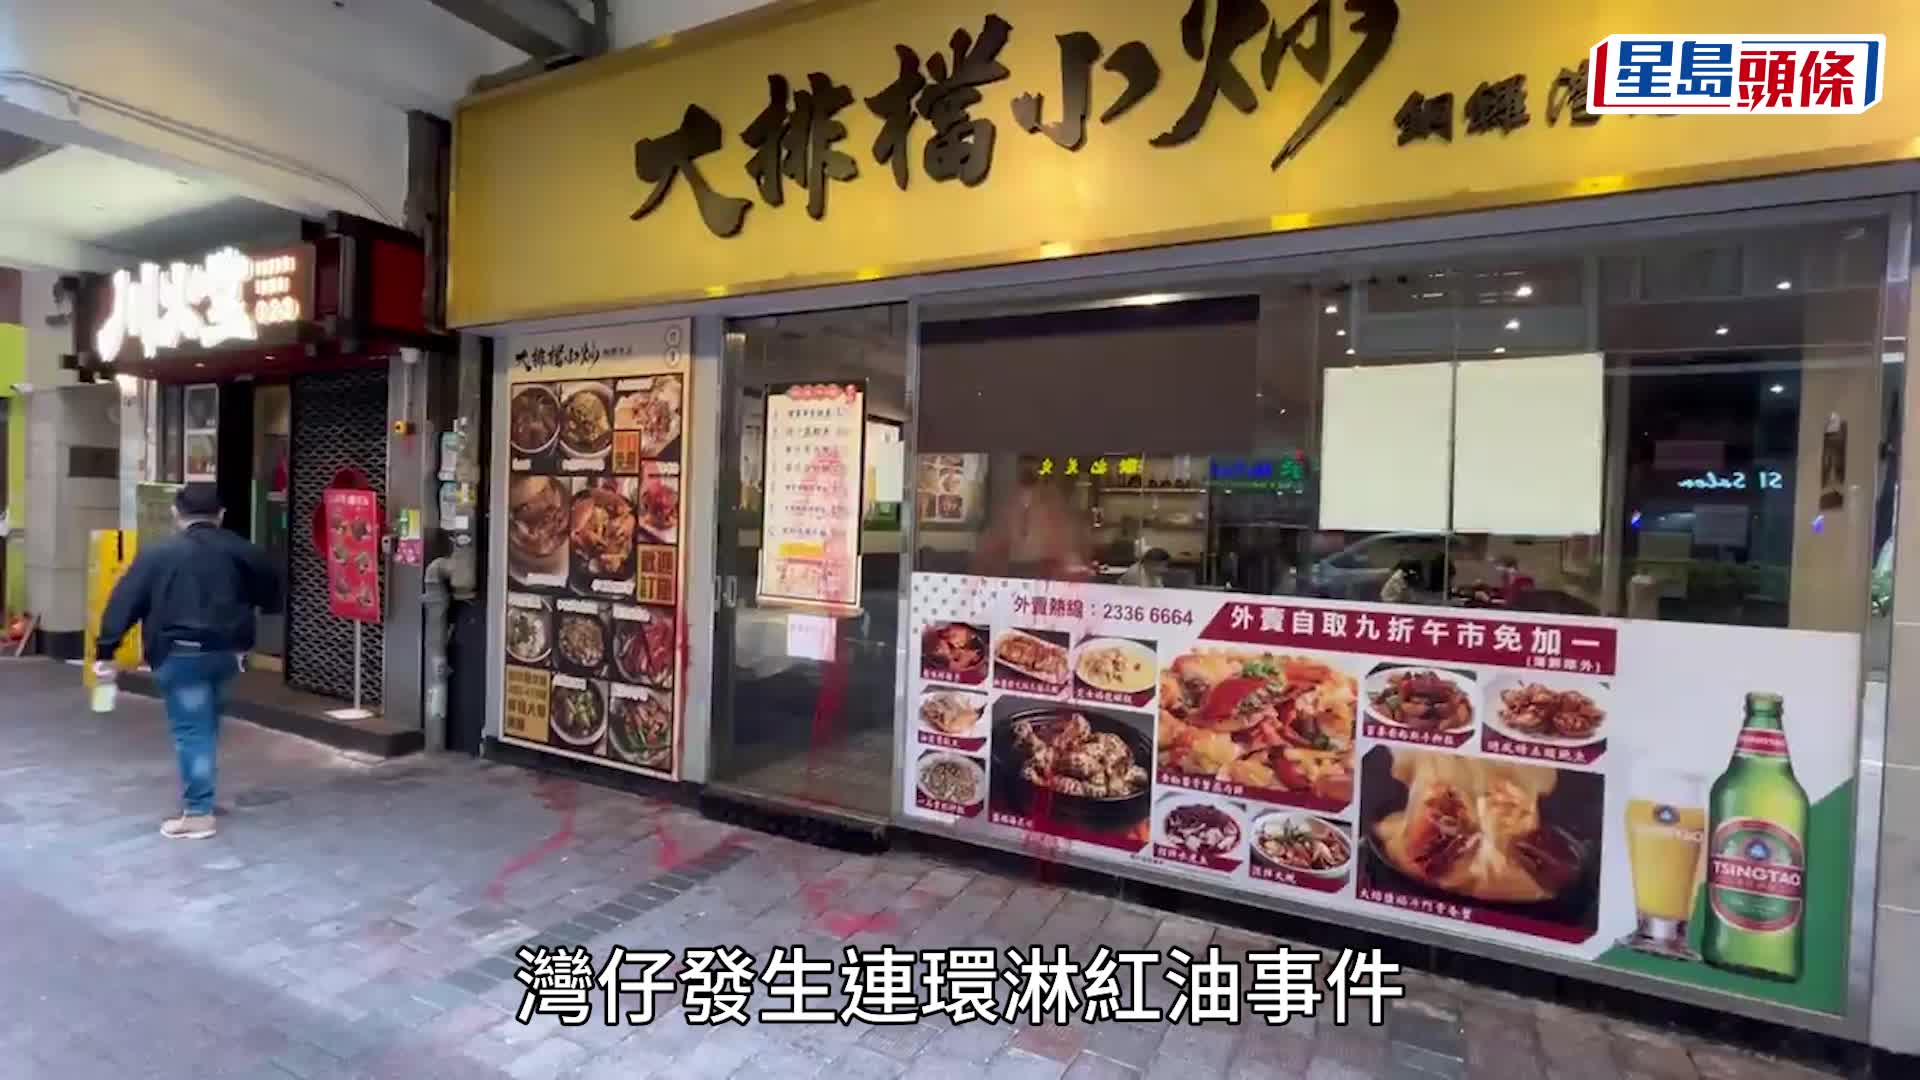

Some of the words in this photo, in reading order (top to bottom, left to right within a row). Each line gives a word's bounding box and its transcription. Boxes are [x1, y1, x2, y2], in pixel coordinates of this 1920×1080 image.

[1393, 58, 1682, 146] 銅鑼灣
[1103, 602, 1144, 622] 2336
[1150, 607, 1194, 627] 6664
[1230, 605, 1601, 657] 外賣自取九折午市免加一
[1713, 861, 1801, 887] TSINGTAO
